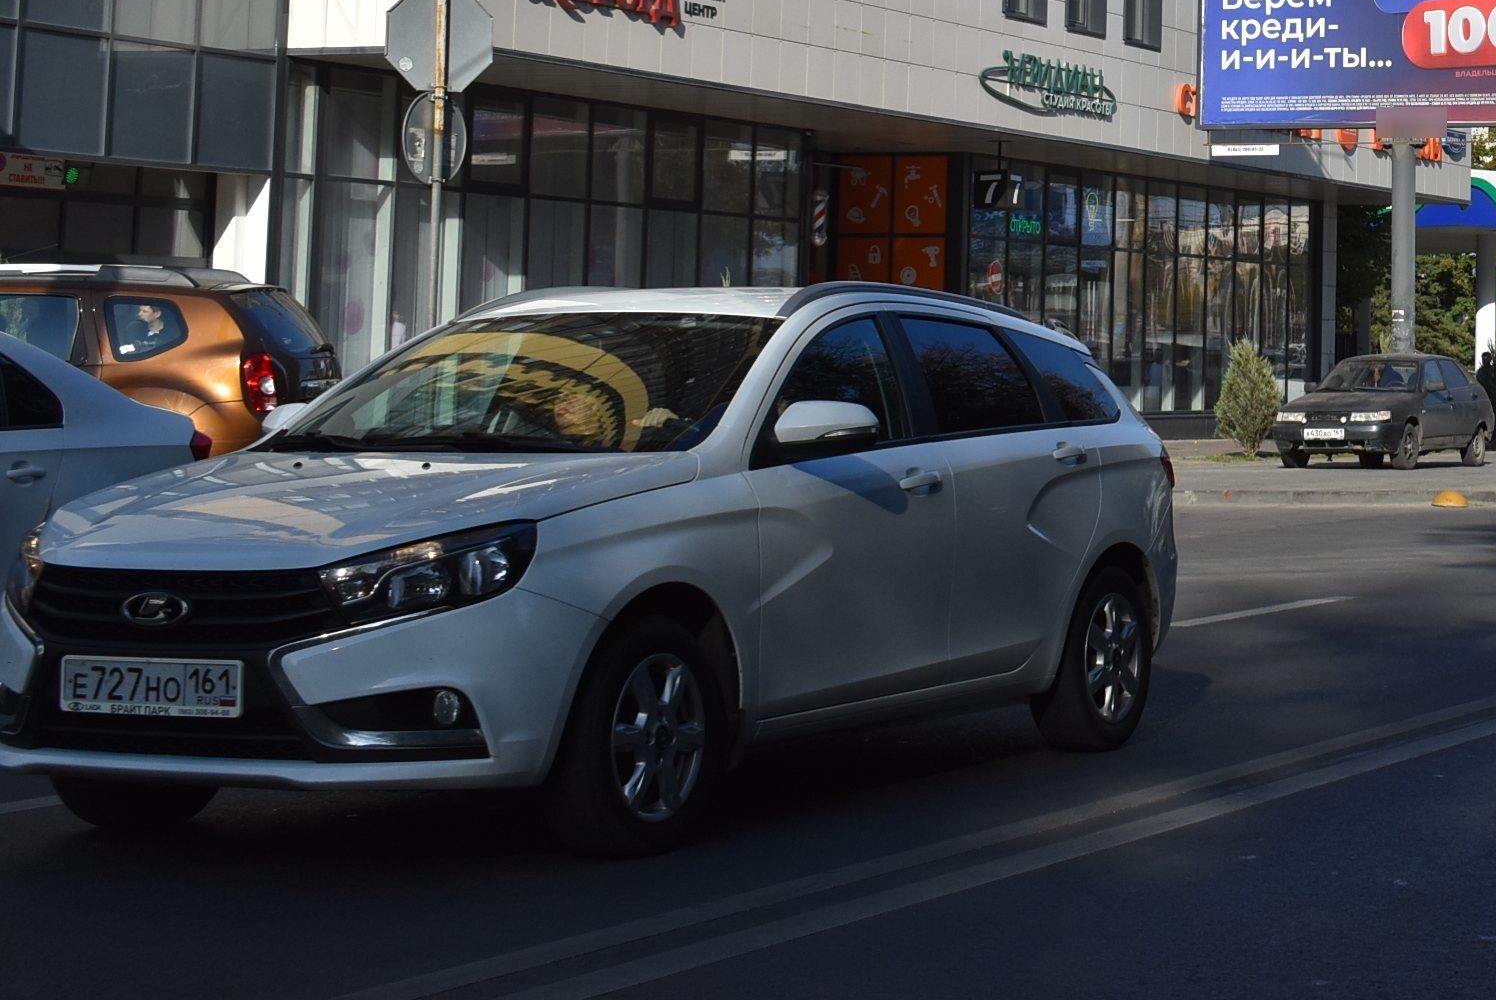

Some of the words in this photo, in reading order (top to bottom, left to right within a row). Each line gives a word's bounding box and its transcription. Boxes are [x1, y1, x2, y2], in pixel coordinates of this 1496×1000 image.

[684, 1, 718, 19] ЦЕНТР
[1221, 17, 1339, 46] креди-
[1043, 93, 1074, 109] СТУДИЯ
[1075, 98, 1113, 116] КРАСОТЫ
[1009, 218, 1041, 235] ОТКРЫТО
[73, 665, 181, 703] Е727НО
[188, 667, 231, 695] 161
[110, 703, 142, 714] БРАЙТ
[144, 706, 171, 717] ПАРК
[196, 696, 219, 706] RUS
